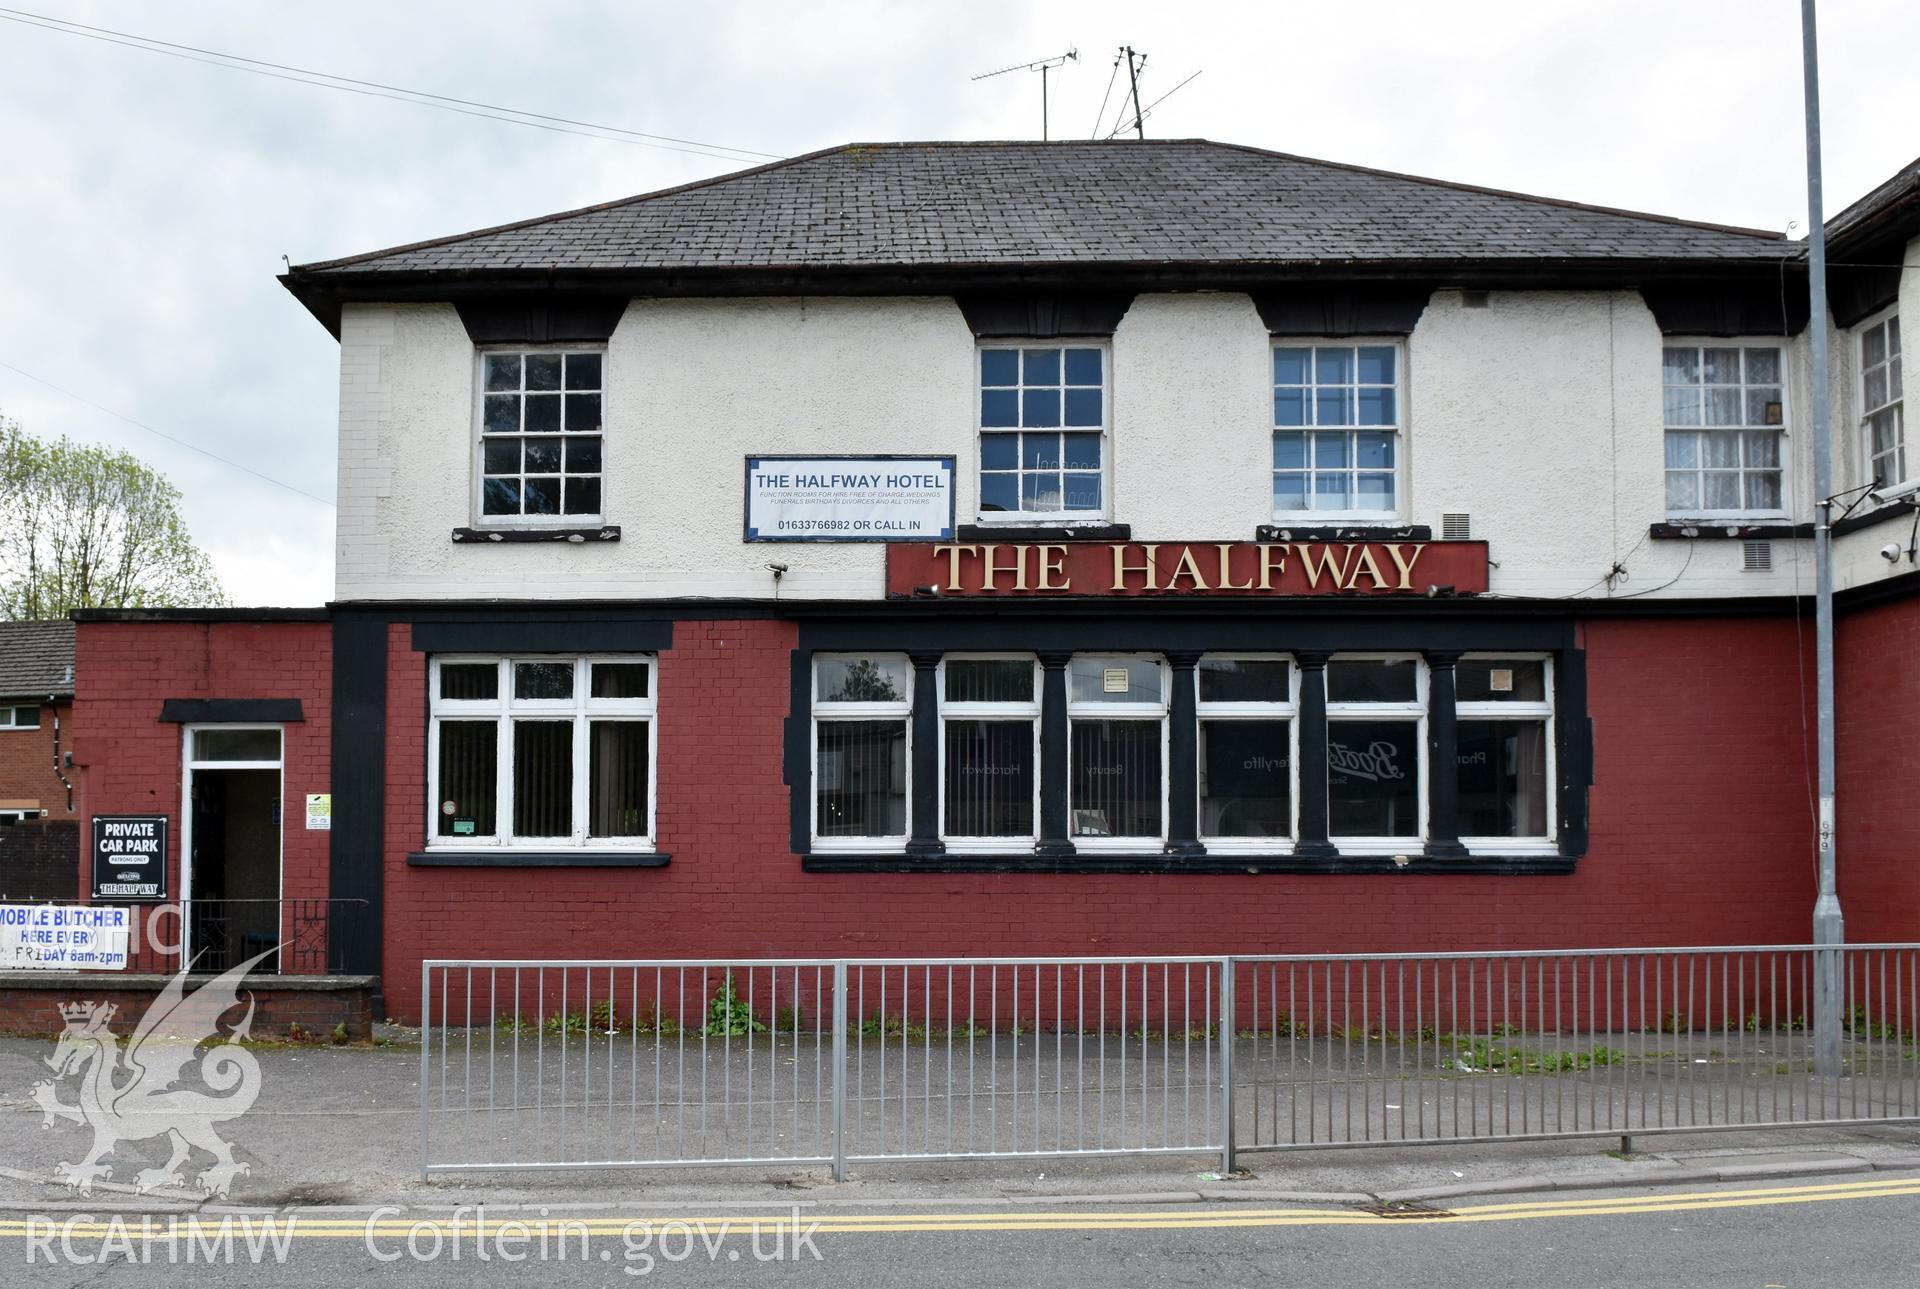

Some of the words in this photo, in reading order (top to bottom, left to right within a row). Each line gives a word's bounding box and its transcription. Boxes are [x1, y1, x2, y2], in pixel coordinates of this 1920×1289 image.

[756, 474, 790, 488] THE
[795, 474, 881, 488] HALFWAY
[886, 474, 945, 488] HOTEL
[778, 520, 850, 530] 01633766982
[853, 520, 871, 530] OR
[874, 520, 905, 530] CALL
[909, 520, 921, 530] IN
[932, 544, 1071, 592] THE
[1107, 544, 1428, 592] HALFWAY
[105, 823, 154, 837] PRIVATE
[99, 839, 123, 852] CAR
[126, 839, 158, 852] PARK
[100, 884, 117, 895] THE
[54, 910, 123, 926] BUTCHER
[21, 930, 52, 942] HERE
[57, 931, 97, 944] EVERY
